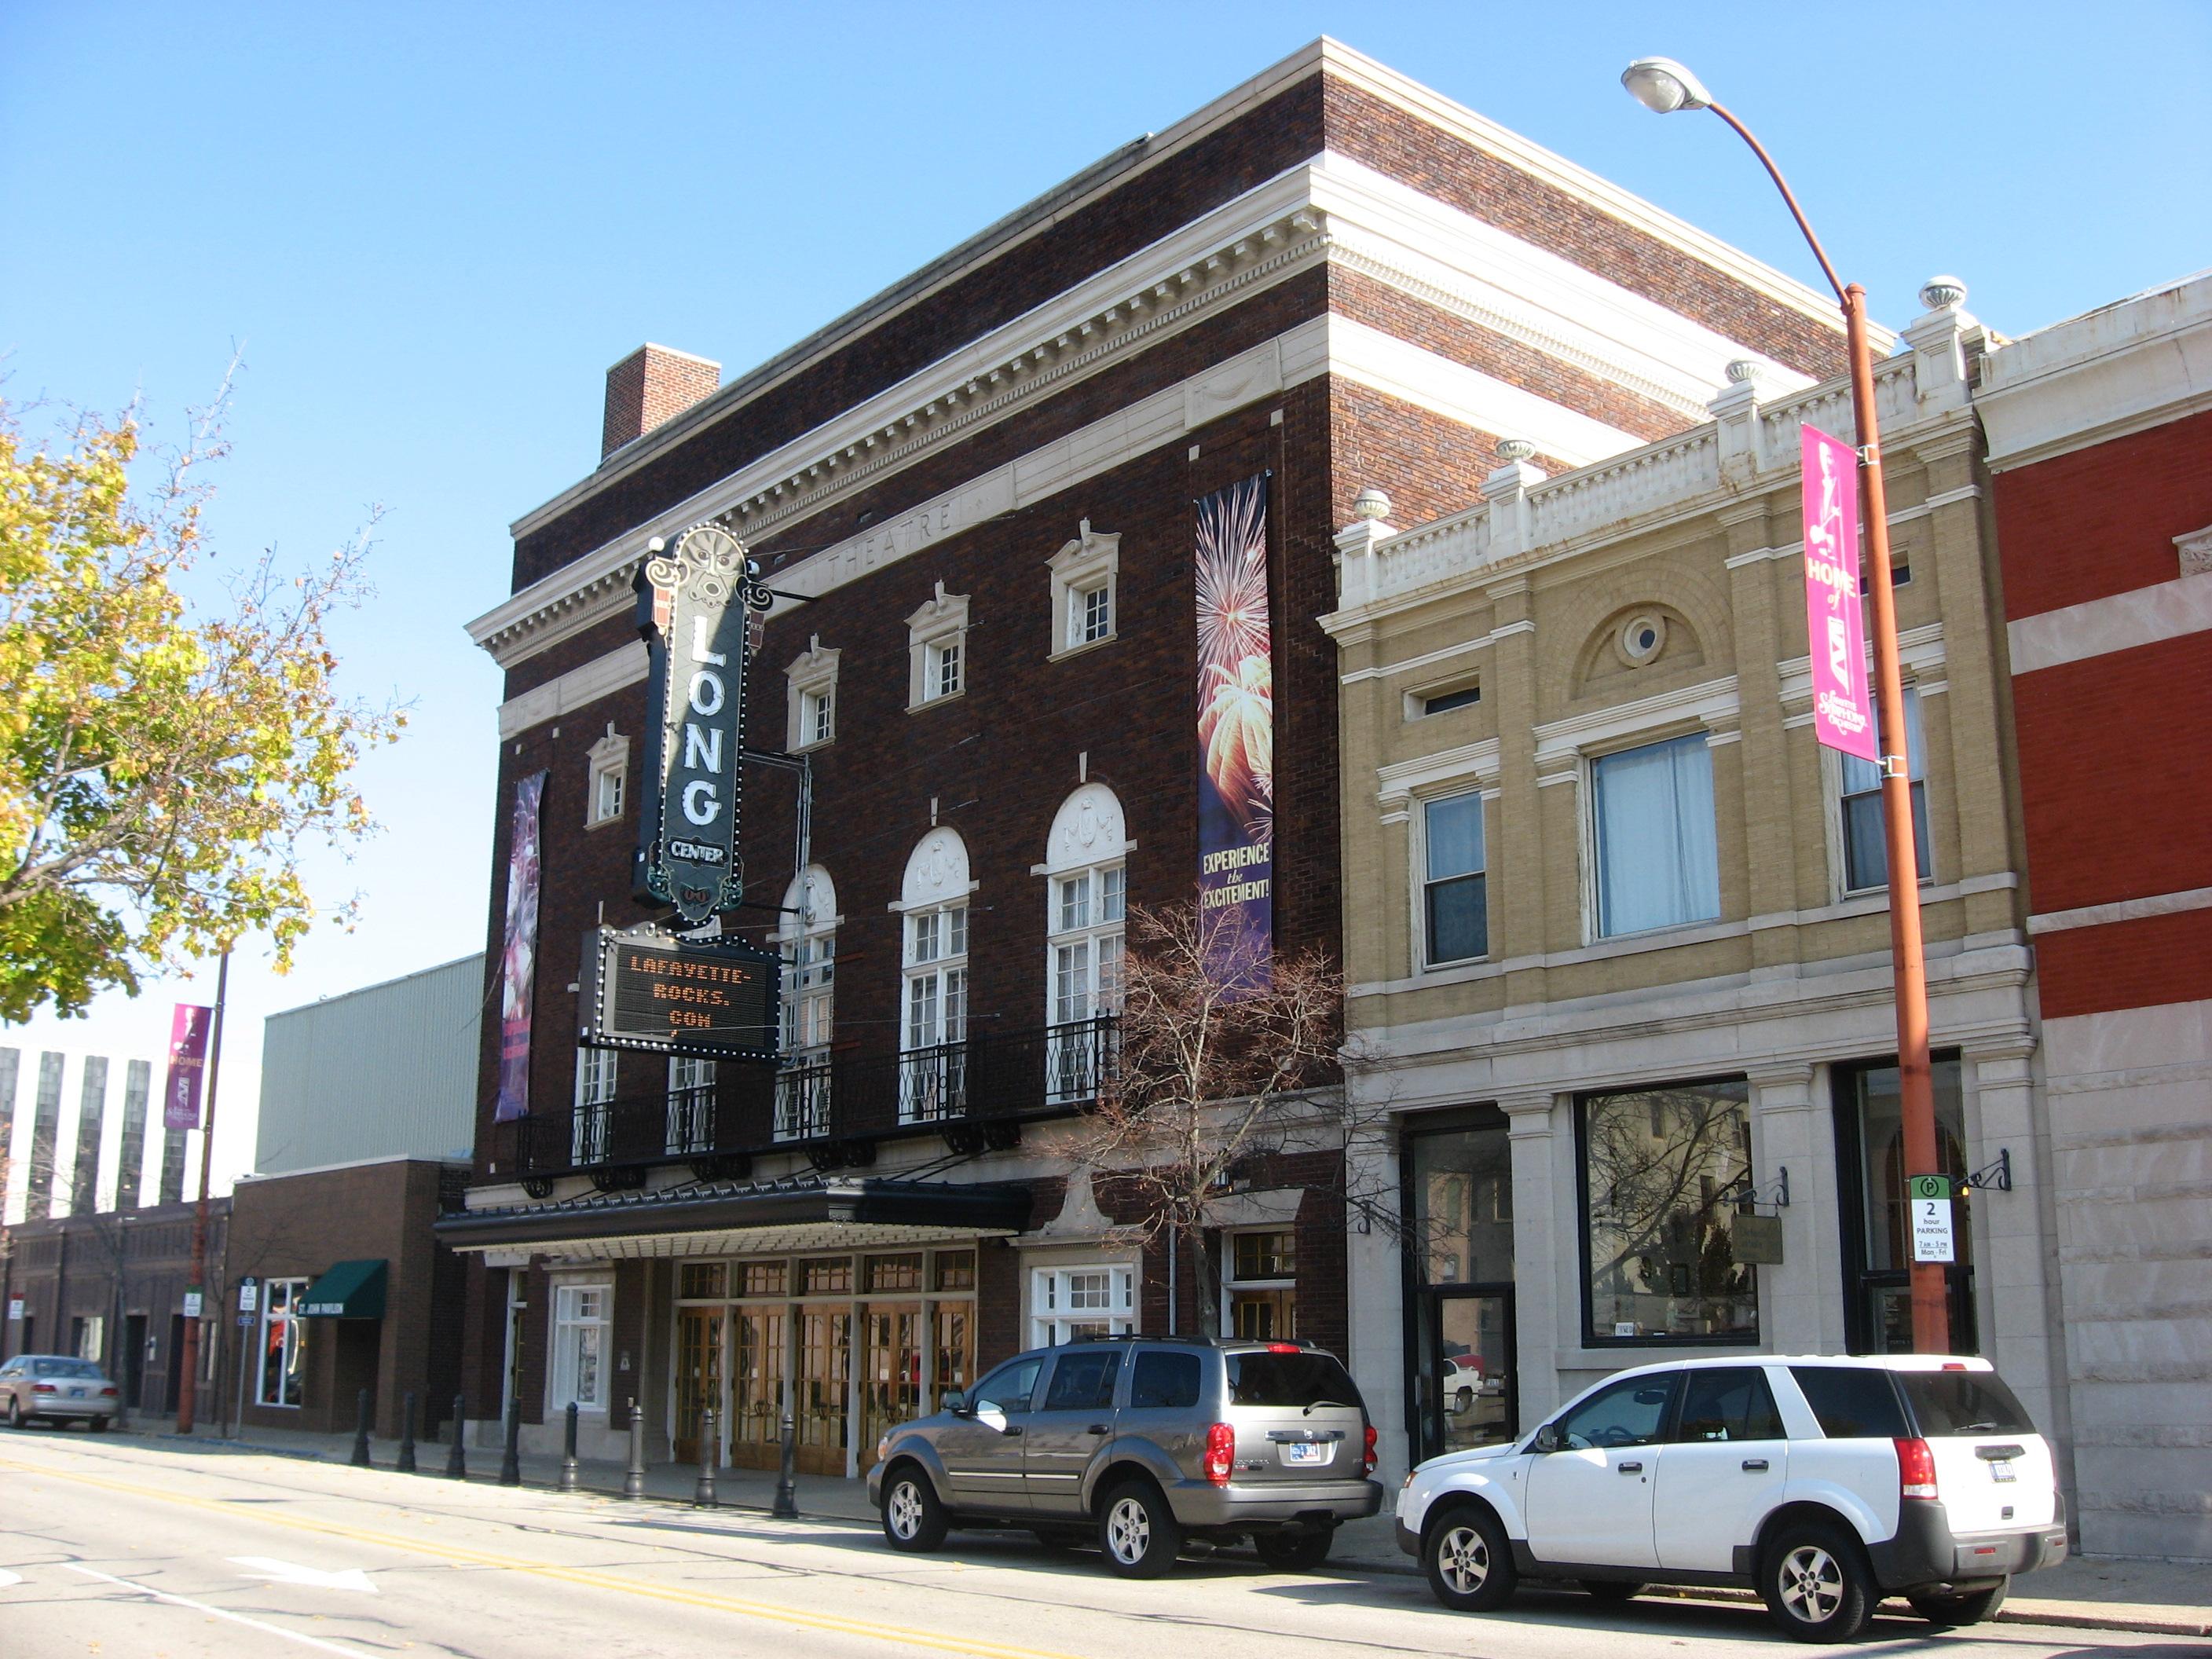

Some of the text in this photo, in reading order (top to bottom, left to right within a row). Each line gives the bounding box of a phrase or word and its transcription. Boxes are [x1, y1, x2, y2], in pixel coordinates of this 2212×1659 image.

[828, 503, 951, 582] THEATRE
[1807, 557, 1856, 599] HOME
[1827, 589, 1840, 610] of
[682, 614, 727, 826] LONG
[671, 840, 723, 863] CENTER
[1203, 842, 1269, 875] EXPERIENCE
[1227, 870, 1243, 884] the
[1203, 879, 1269, 910] EXCITEMENT!
[669, 1010, 711, 1027] COM
[170, 1055, 203, 1068] HOME
[1927, 1203, 1936, 1215] 2
